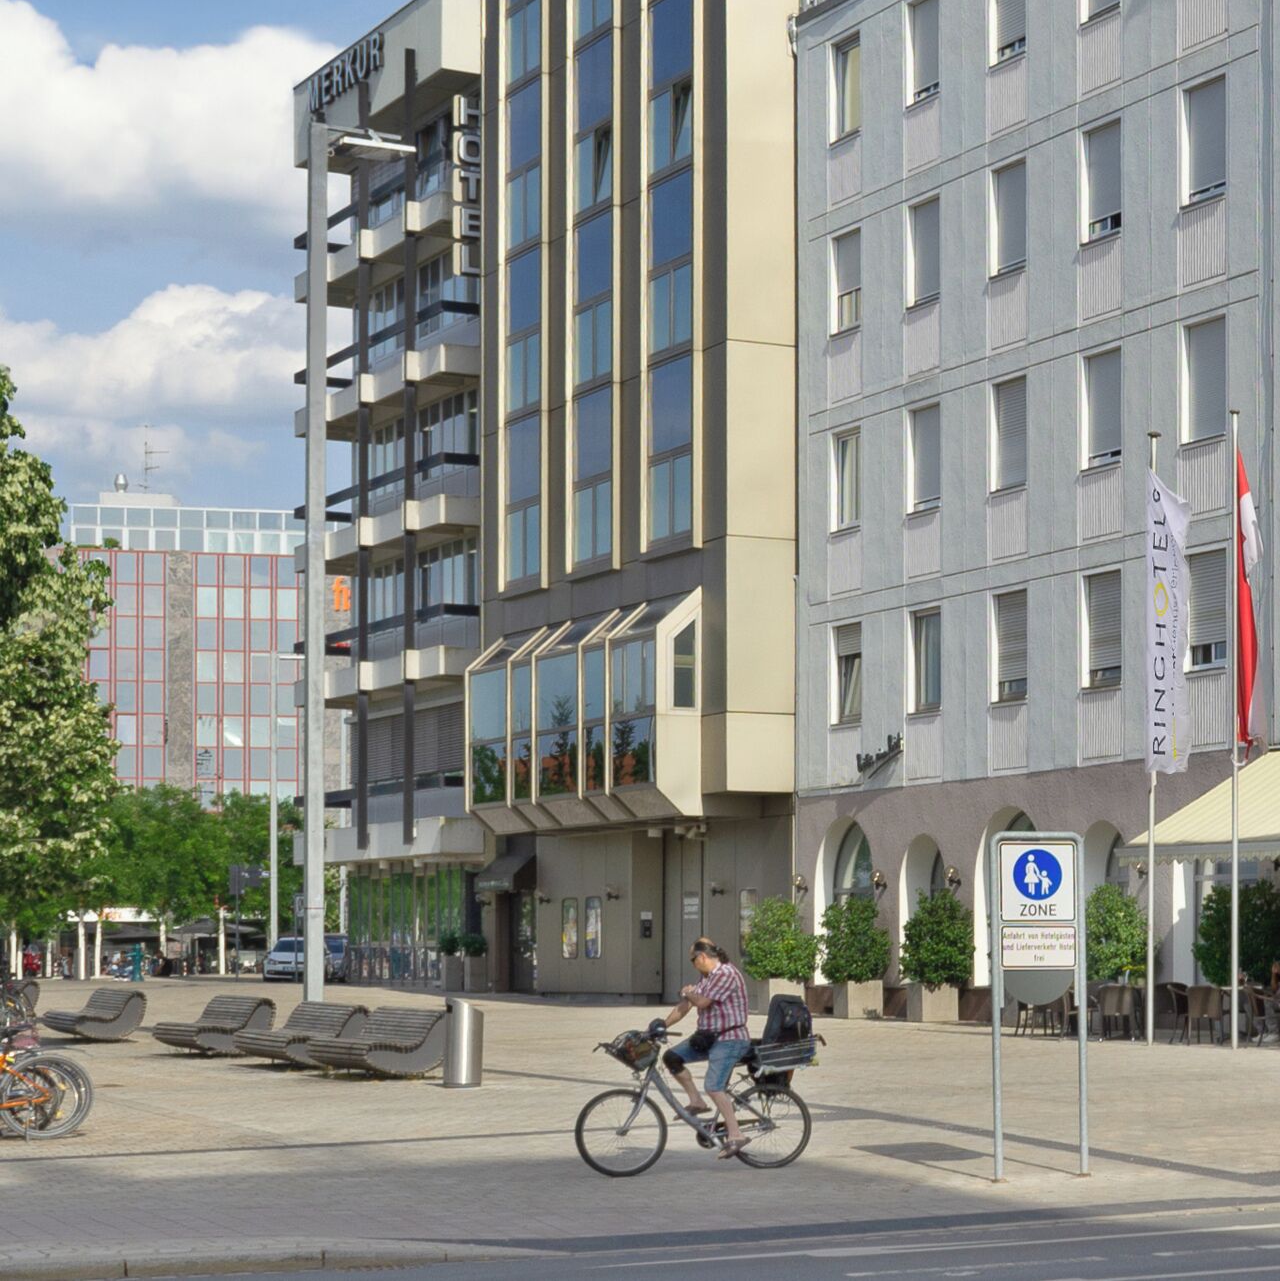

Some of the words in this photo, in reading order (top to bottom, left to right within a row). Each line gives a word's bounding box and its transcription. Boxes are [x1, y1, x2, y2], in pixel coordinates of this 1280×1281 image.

[306, 31, 385, 113] MERKUR
[454, 94, 481, 276] HOTEL
[1019, 903, 1057, 917] ZONE
